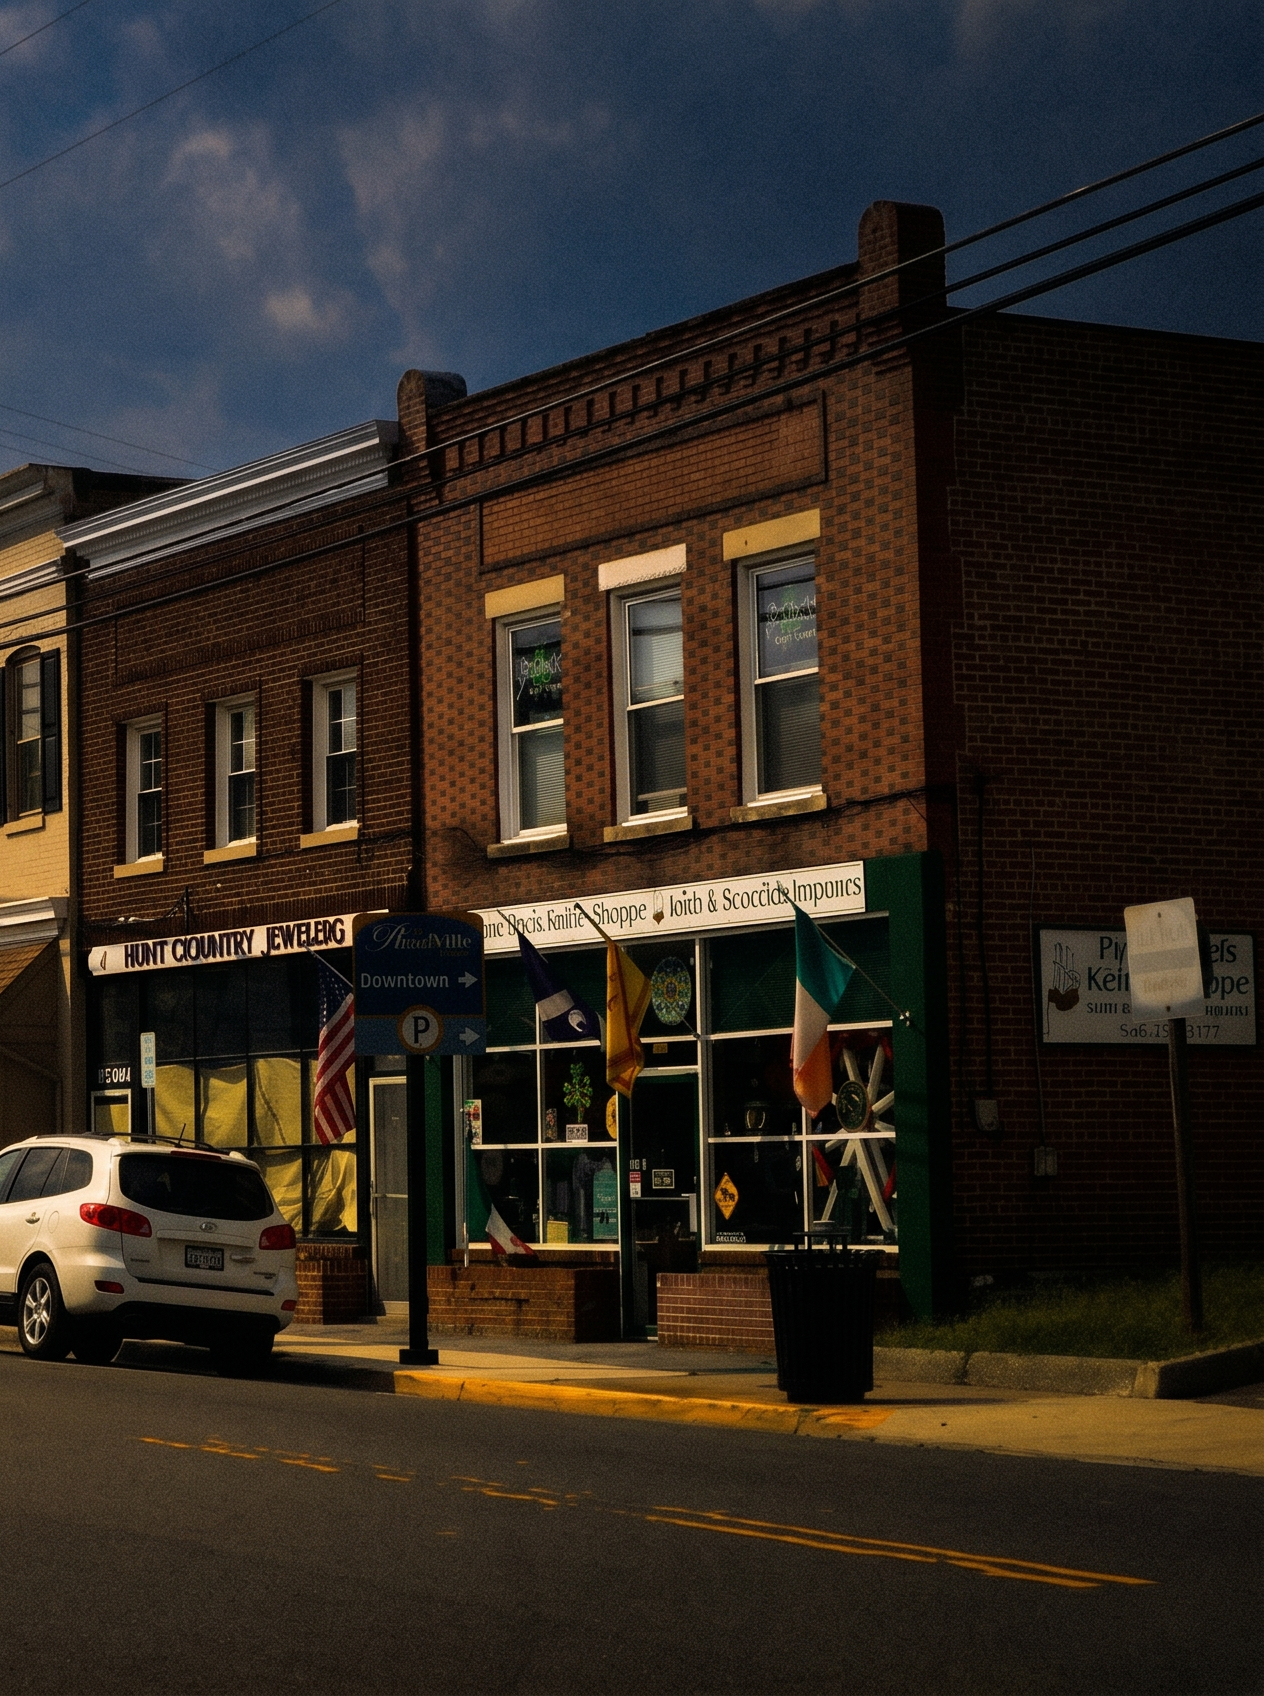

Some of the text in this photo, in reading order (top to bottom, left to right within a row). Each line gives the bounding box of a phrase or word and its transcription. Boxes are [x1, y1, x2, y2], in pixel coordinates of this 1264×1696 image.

[592, 902, 647, 929] Shoppe
[707, 888, 718, 914] &
[124, 940, 169, 968] HUNT
[360, 973, 449, 988] Downtown
[412, 1015, 430, 1044] P
